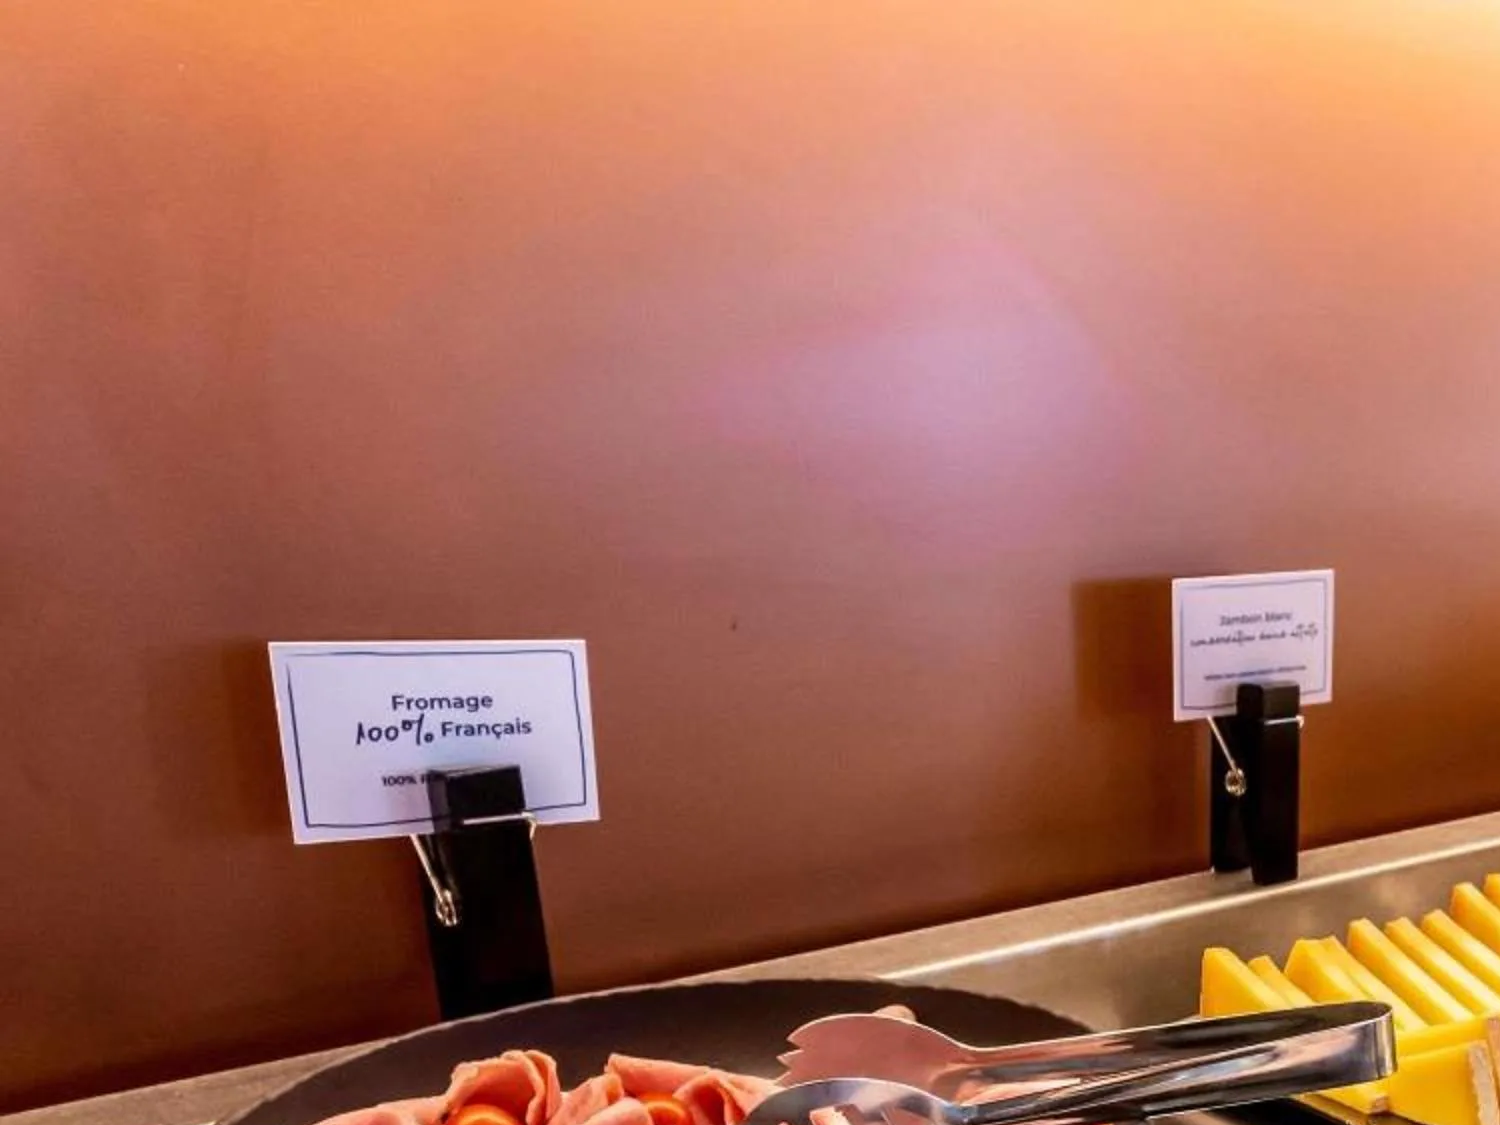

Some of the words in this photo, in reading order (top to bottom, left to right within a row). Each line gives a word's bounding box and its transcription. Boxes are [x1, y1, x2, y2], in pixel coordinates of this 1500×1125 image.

[391, 694, 493, 712] Fromage
[356, 713, 434, 746] 100%
[440, 717, 532, 739] Français
[382, 775, 417, 787] 100%
